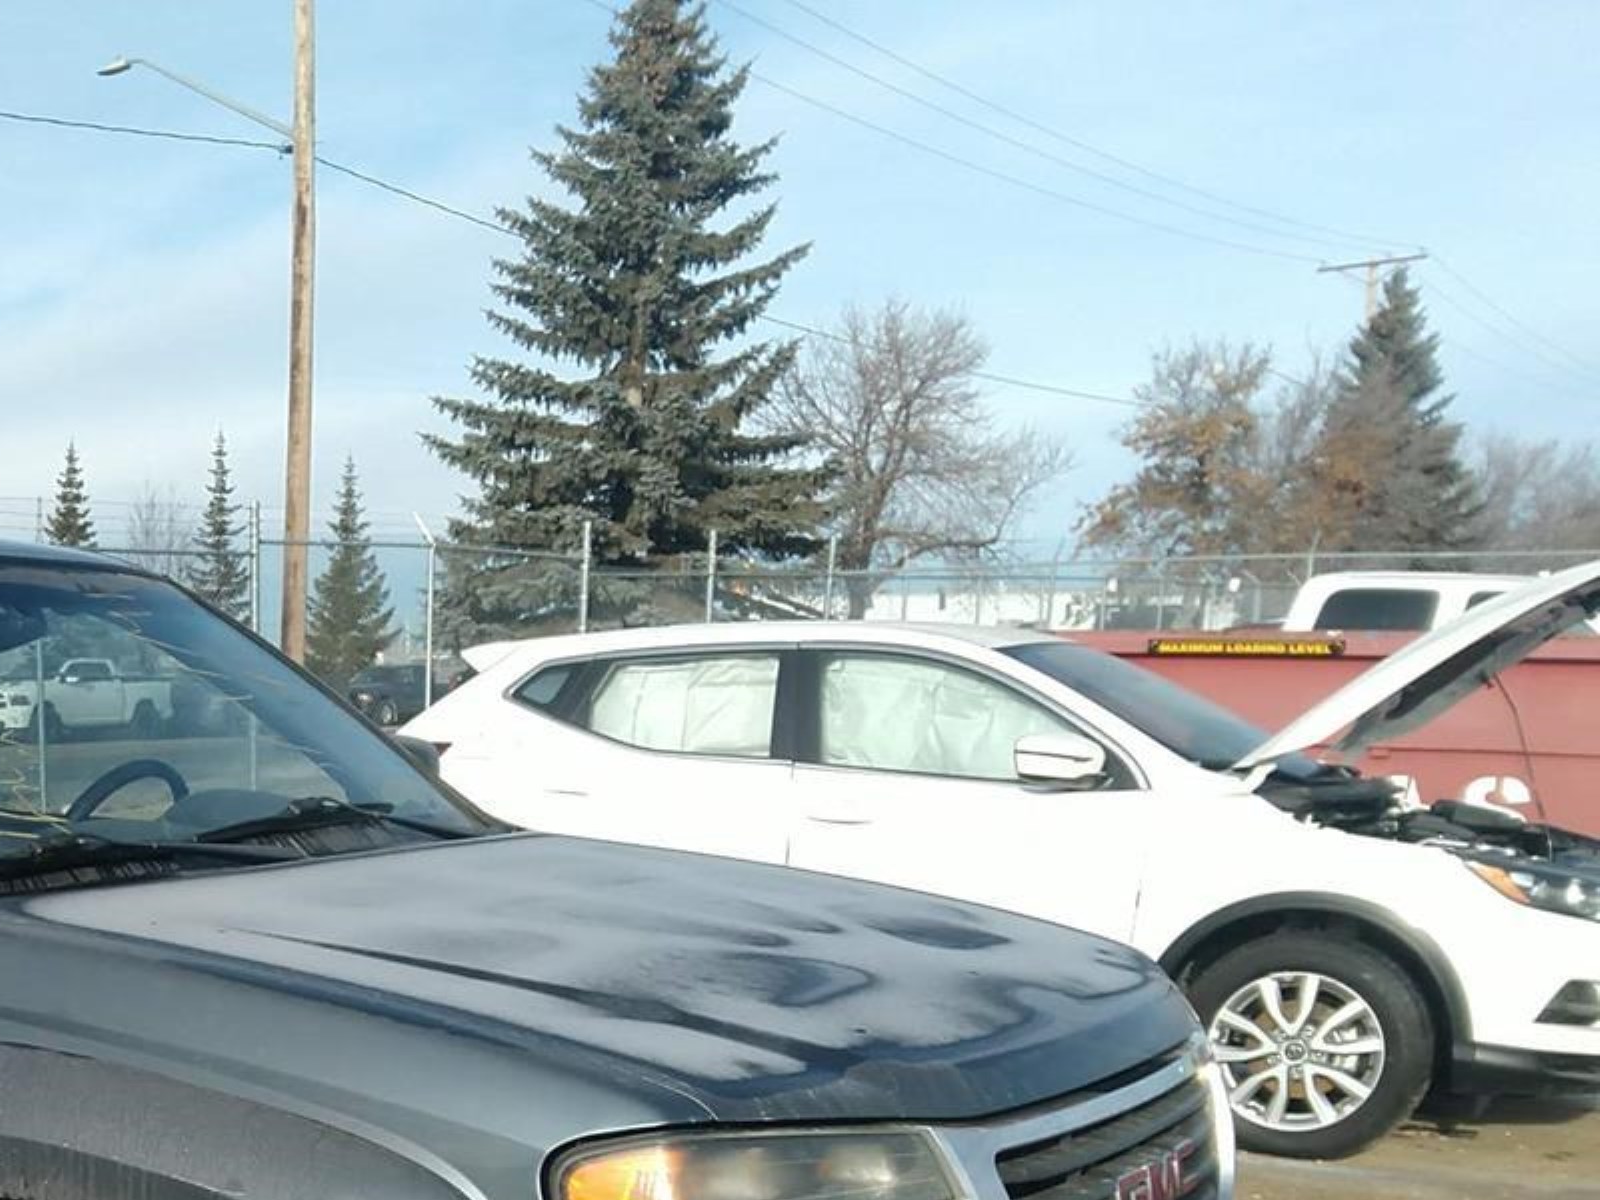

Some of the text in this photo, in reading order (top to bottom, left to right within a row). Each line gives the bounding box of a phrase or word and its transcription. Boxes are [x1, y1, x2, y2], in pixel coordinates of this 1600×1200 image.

[1158, 641, 1332, 655] MAXIMUM LOADING LEVEL
